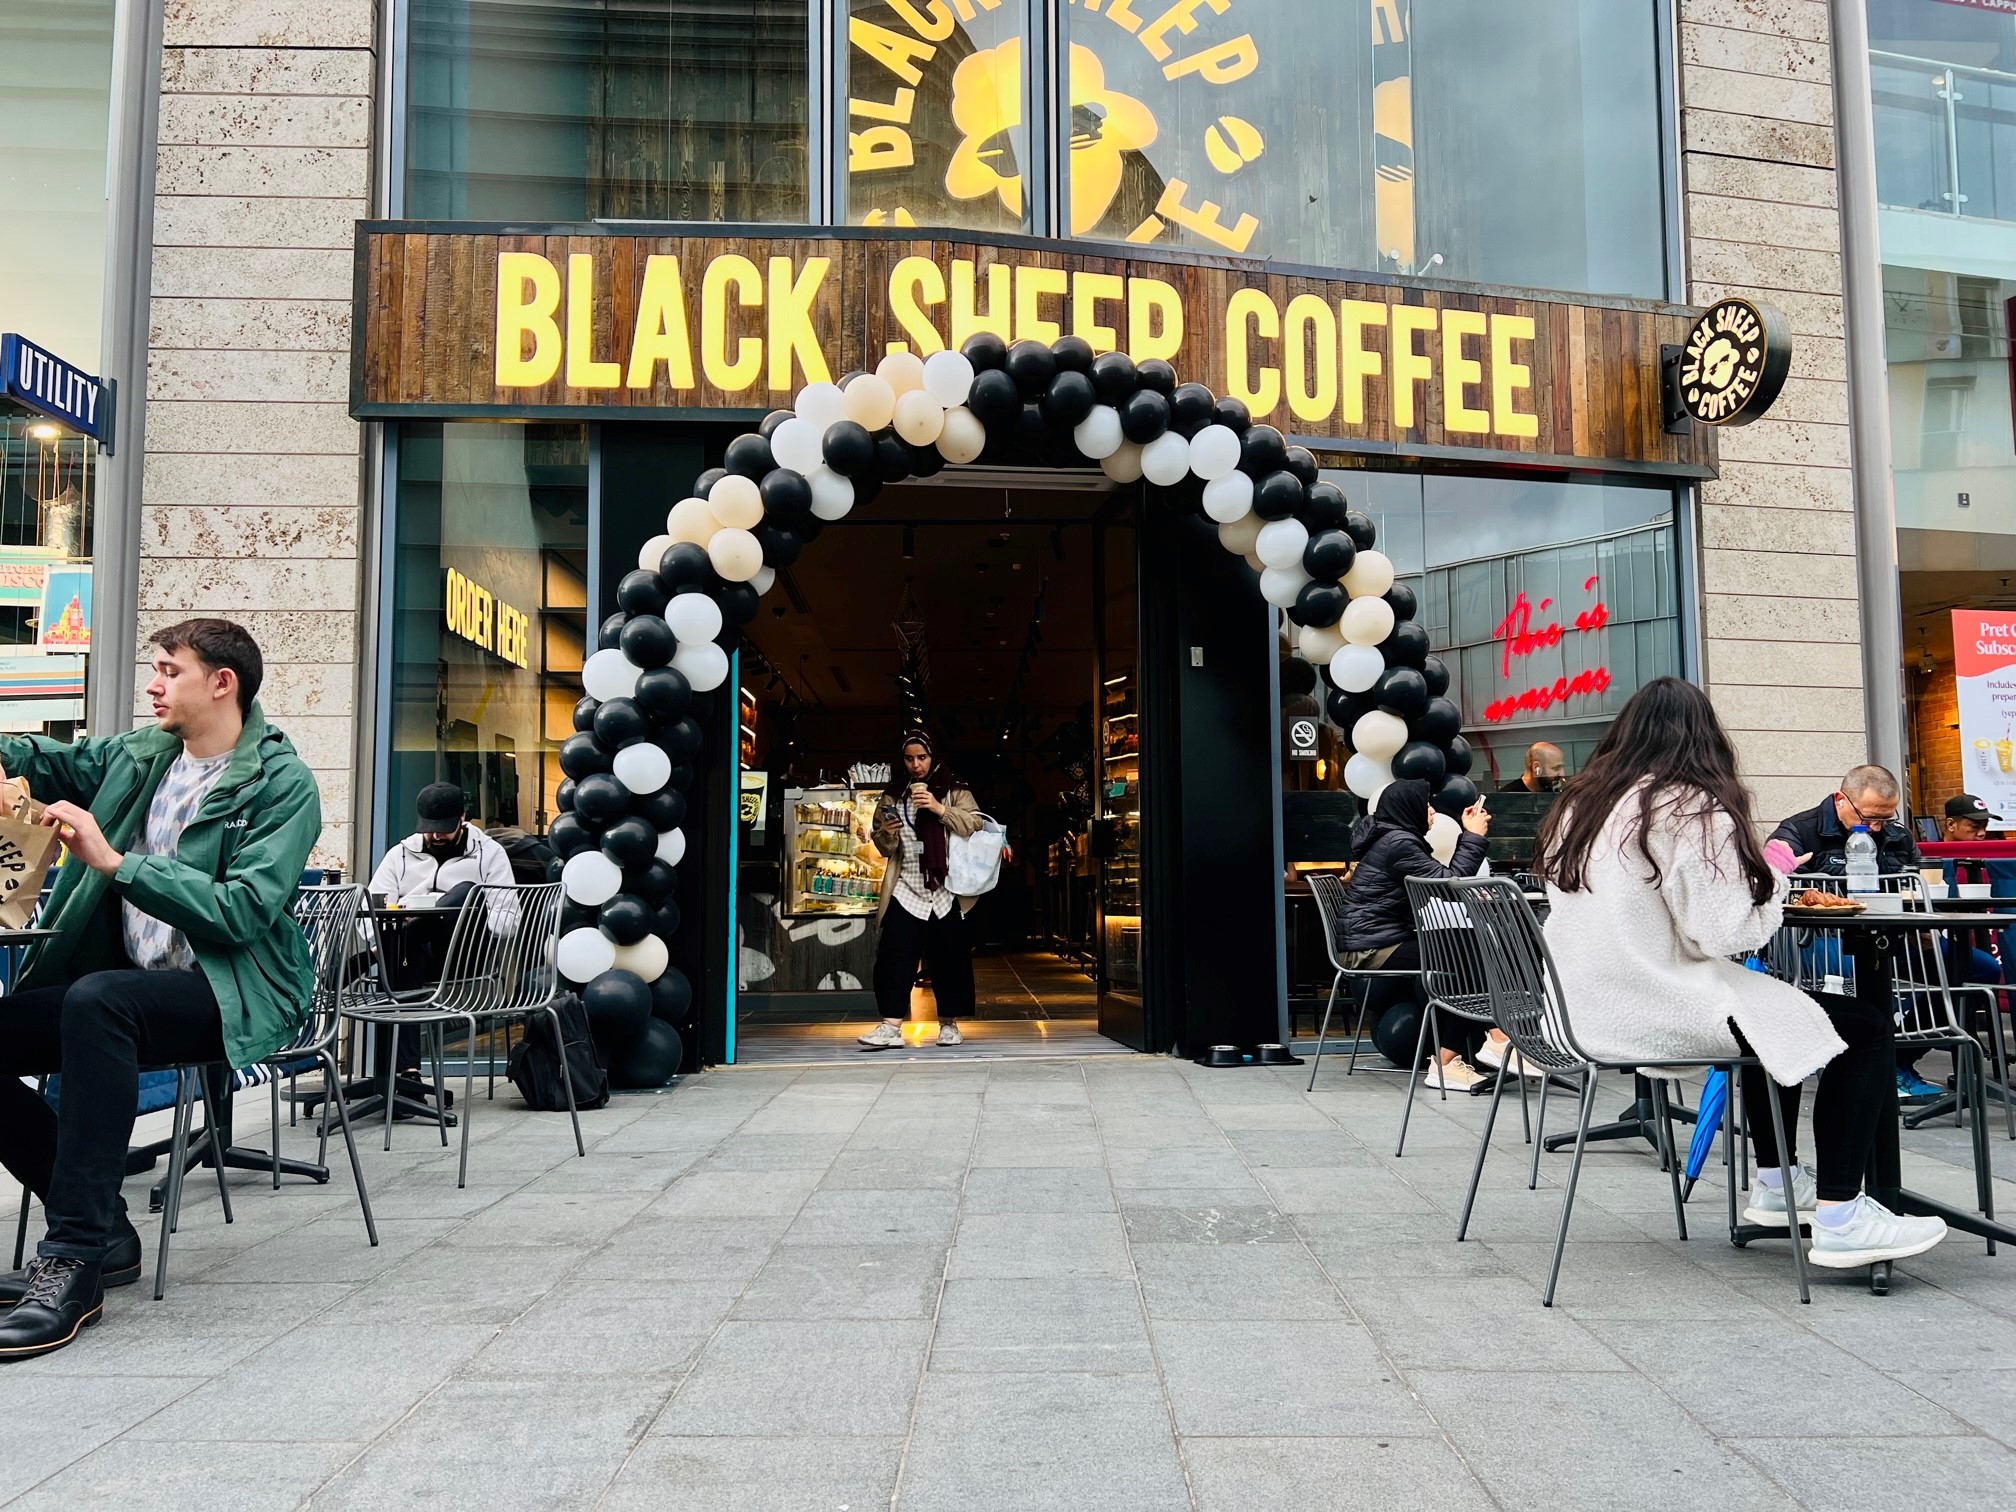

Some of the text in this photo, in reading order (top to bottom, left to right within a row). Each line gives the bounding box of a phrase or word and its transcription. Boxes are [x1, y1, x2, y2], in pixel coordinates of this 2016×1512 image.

[850, 0, 1001, 171] BLAC
[20, 344, 98, 424] UTILITY
[495, 252, 1538, 437] BLACK SHEEP COFFEE
[1682, 305, 1759, 419] BLACK SHEEP COFFEE
[446, 567, 528, 669] ORDER HERE
[1494, 576, 1609, 679] This is
[1976, 639, 2016, 655] Subsc
[1980, 622, 2009, 637] Pret
[0, 835, 25, 871] EEP
